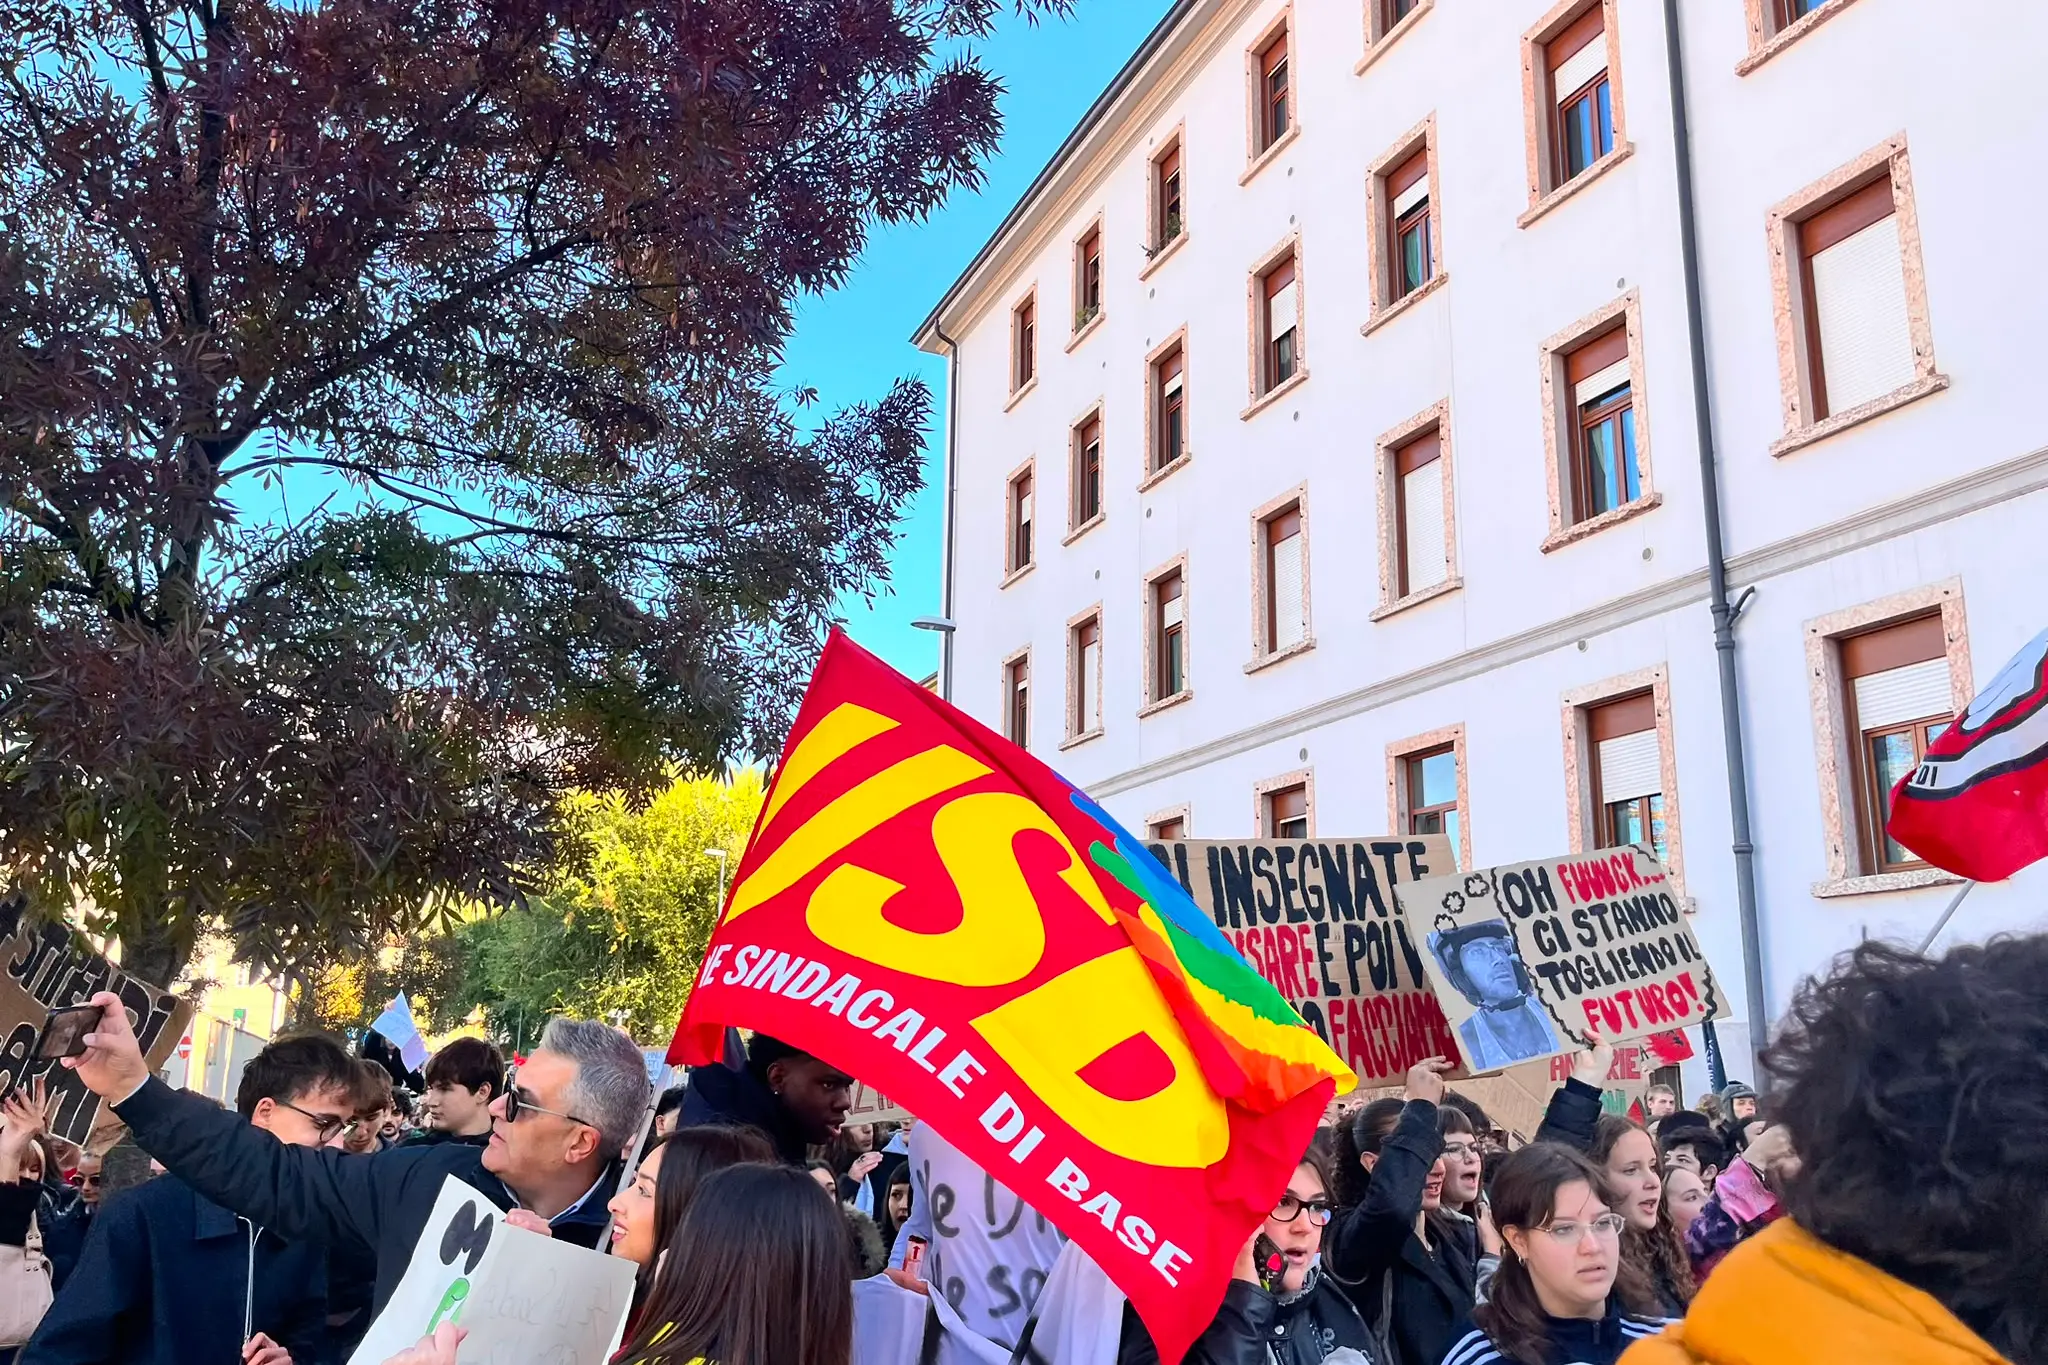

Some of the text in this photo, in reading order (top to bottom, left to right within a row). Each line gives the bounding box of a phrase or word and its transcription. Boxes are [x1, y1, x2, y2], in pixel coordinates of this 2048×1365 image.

[1207, 842, 1429, 928] INSEGNATE
[1502, 866, 1558, 918] OH
[1315, 922, 1341, 996] E
[1344, 919, 1398, 995] POI
[1532, 892, 1679, 957] CI STANNO
[1535, 931, 1703, 1001] TOGLIENDO IL
[1581, 971, 1705, 1034] FUTURO!
[723, 944, 988, 1100] SINDACALE
[978, 1091, 1046, 1164] DI
[1045, 1156, 1193, 1288] BASE
